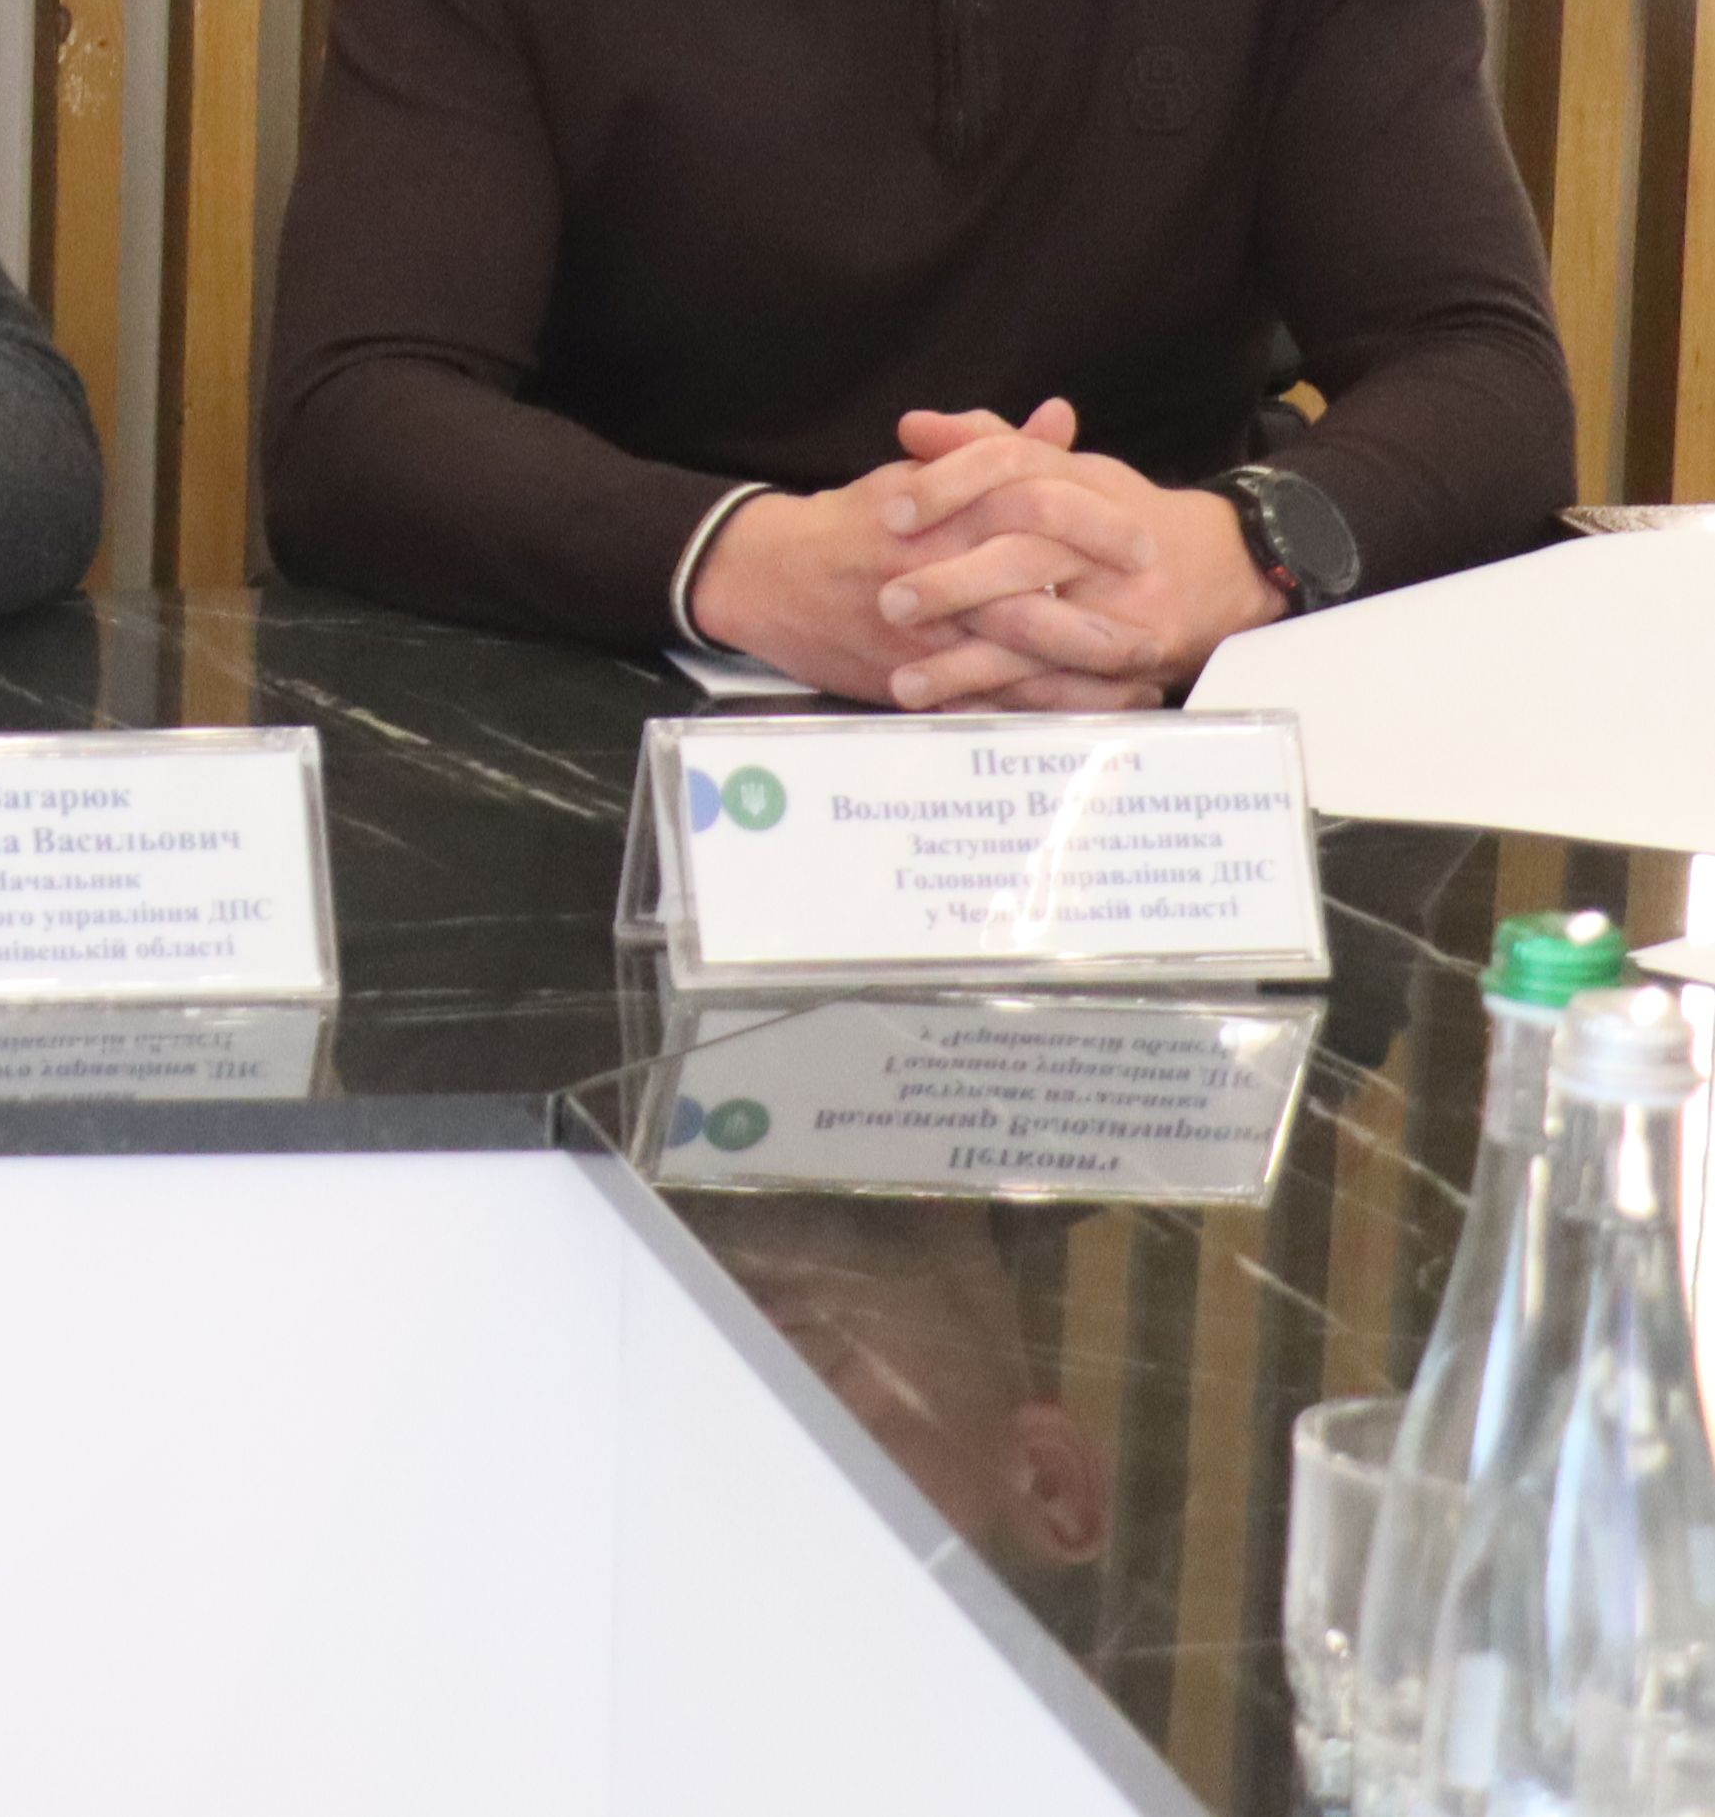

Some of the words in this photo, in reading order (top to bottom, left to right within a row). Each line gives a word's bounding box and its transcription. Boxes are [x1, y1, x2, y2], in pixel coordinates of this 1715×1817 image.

[831, 795, 1016, 825] Володимир
[1027, 791, 1292, 820] Воодимирович
[33, 827, 240, 854] Васильович
[1211, 859, 1276, 885] ДПС
[43, 902, 200, 932] управління
[208, 899, 272, 925] ДПС
[925, 909, 938, 930] у
[1140, 896, 1239, 919] області
[135, 935, 235, 959] області
